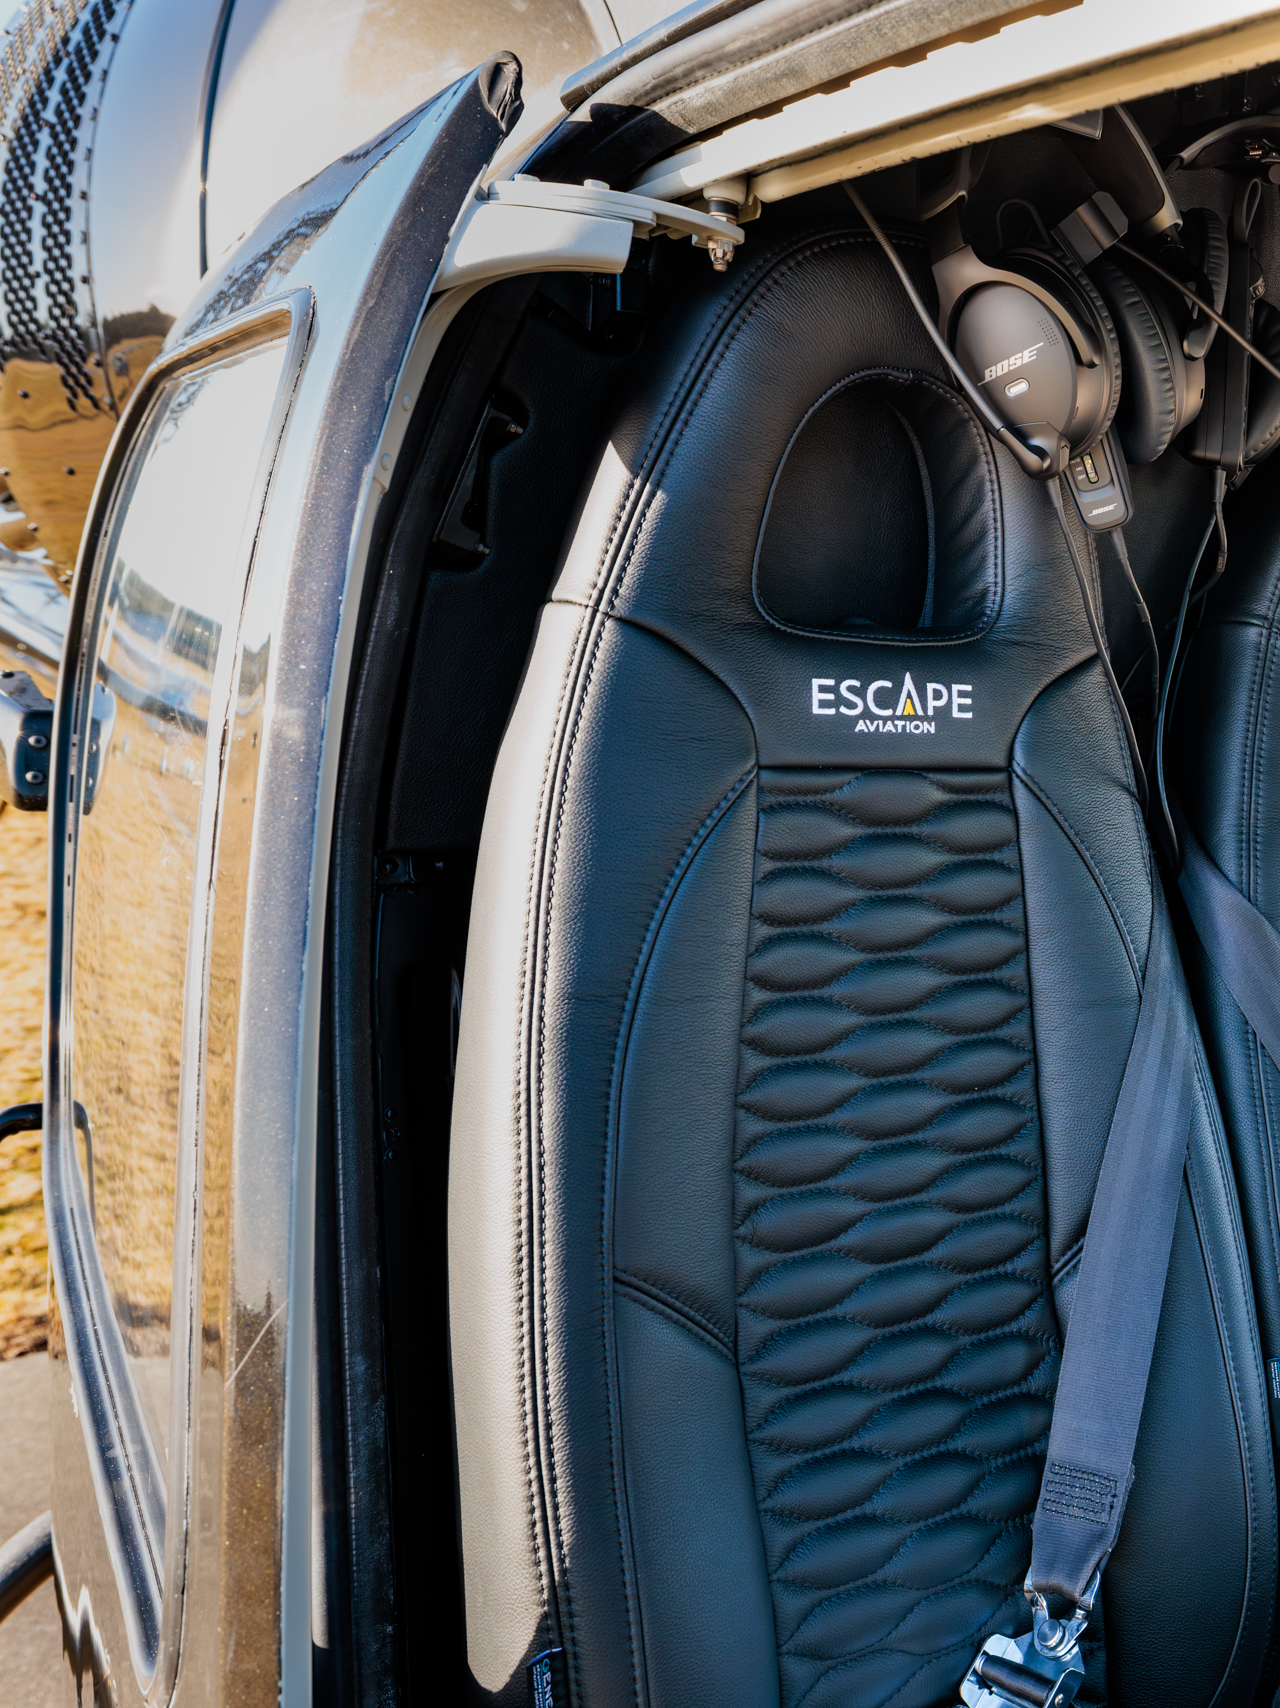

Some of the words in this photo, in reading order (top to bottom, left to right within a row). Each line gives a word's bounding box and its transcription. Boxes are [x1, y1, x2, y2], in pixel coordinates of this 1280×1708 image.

[978, 342, 1044, 386] BOSE
[1088, 503, 1118, 516] BOSE
[811, 671, 973, 718] ESCAPE
[854, 719, 936, 734] AVIATION
